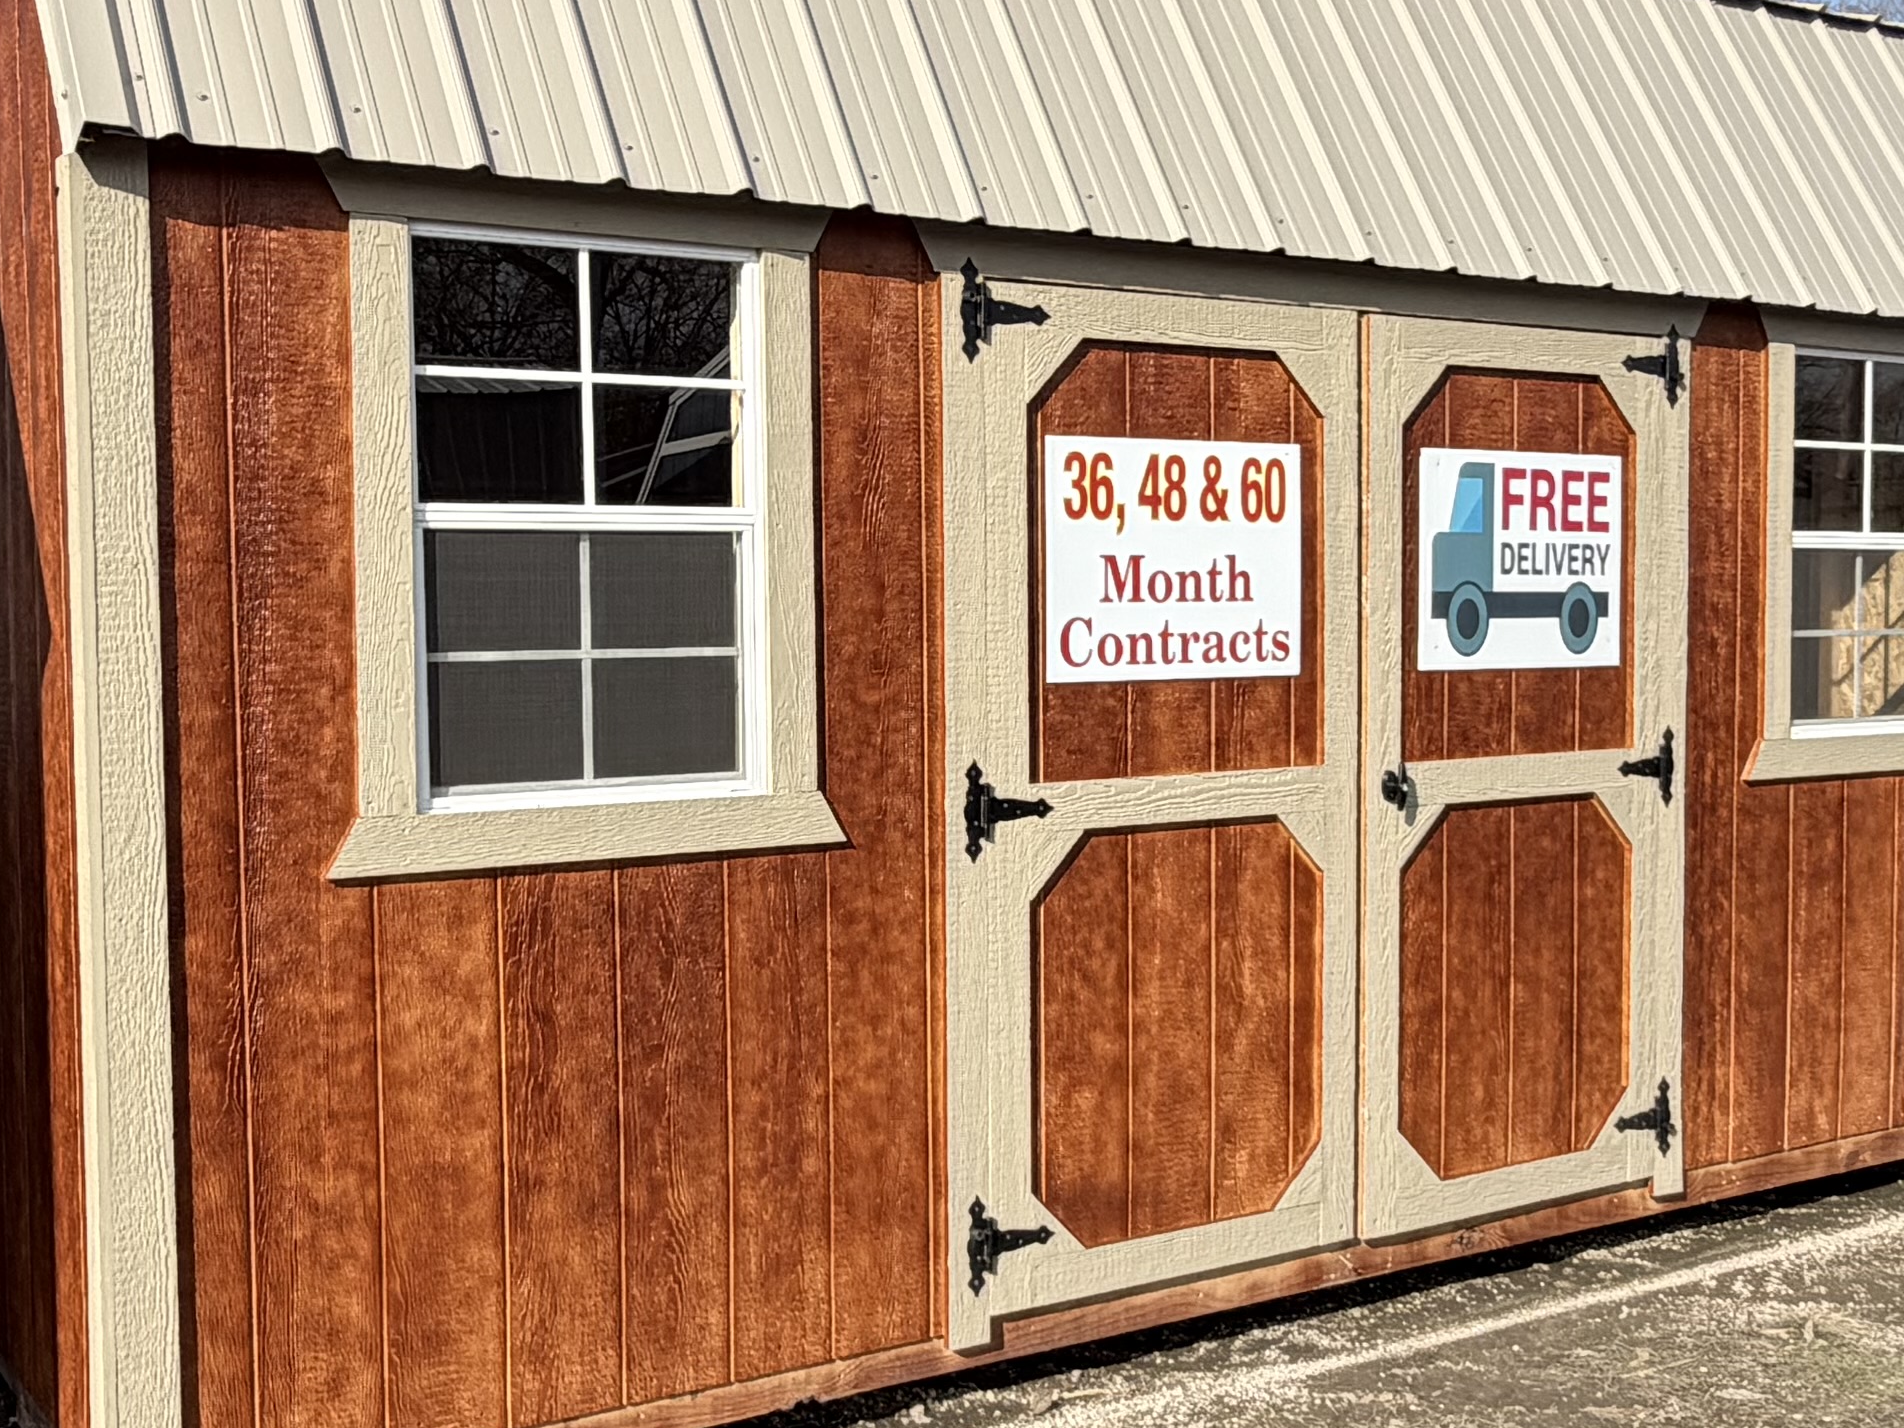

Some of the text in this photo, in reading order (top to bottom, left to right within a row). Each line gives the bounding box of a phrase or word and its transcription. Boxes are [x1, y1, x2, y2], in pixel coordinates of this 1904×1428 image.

[1063, 451, 1287, 535] 36, 48 & 60
[1500, 467, 1611, 533] FREE
[1099, 554, 1254, 604] Month
[1500, 542, 1611, 577] DELIVERY
[1059, 617, 1290, 668] Contracts
